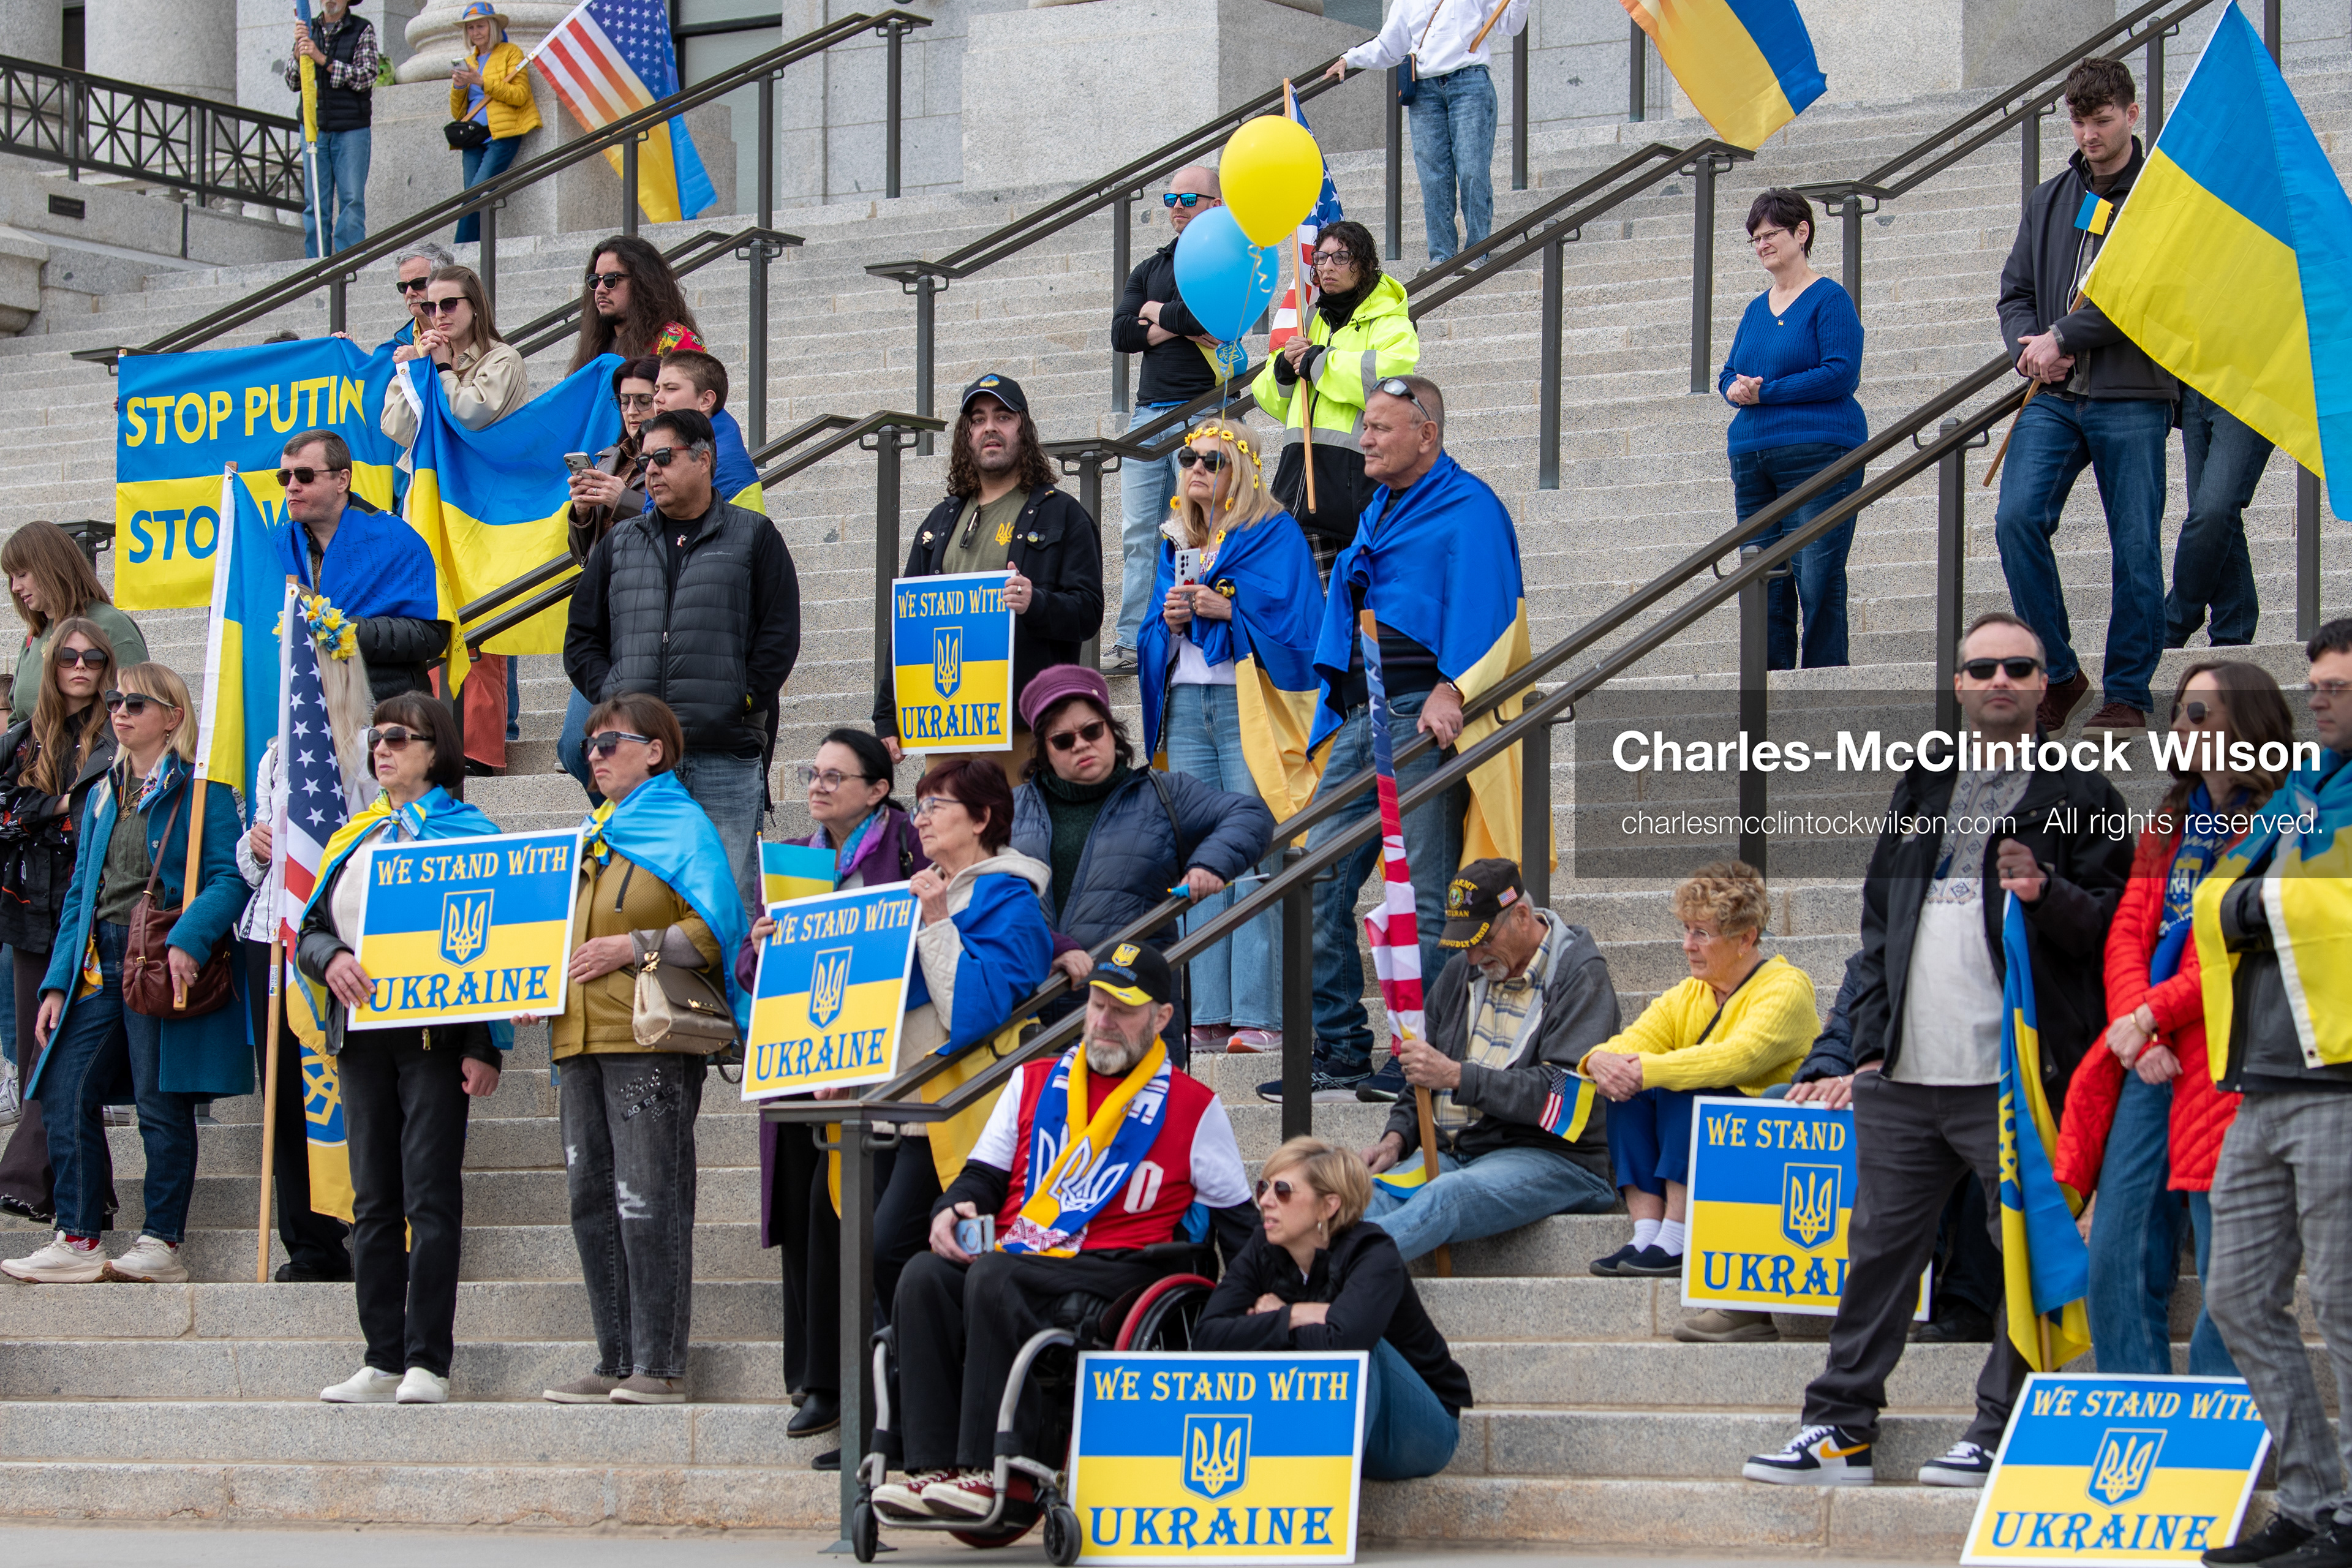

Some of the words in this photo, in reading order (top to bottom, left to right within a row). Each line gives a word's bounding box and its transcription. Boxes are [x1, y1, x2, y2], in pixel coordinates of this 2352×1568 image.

[126, 390, 233, 447] STOP
[245, 375, 368, 437] PUTIN
[129, 505, 221, 564] STO
[897, 589, 916, 619] WE
[920, 590, 964, 617] STAND
[968, 584, 1006, 614] WITH
[901, 703, 1001, 741] UKRAINE
[377, 854, 413, 886] WE
[419, 852, 499, 883] STAND
[508, 843, 569, 876] WITH
[771, 912, 799, 946] WE
[800, 907, 860, 941] STAND
[864, 897, 913, 932] WITH
[369, 965, 552, 1012] UKRAINE
[756, 1027, 888, 1081] UKRAINE
[1706, 1111, 1747, 1147] WE
[1755, 1118, 1846, 1152] STAND
[1702, 1250, 1849, 1298] UKRAI
[1093, 1365, 1141, 1401] WE
[1150, 1371, 1257, 1401] STAND
[1268, 1365, 1349, 1401] WITH
[2030, 1384, 2079, 1417] WE
[2079, 1390, 2182, 1418] STAND
[1088, 1506, 1335, 1551] UKRAINE
[1992, 1511, 2220, 1553] UKRAINE
